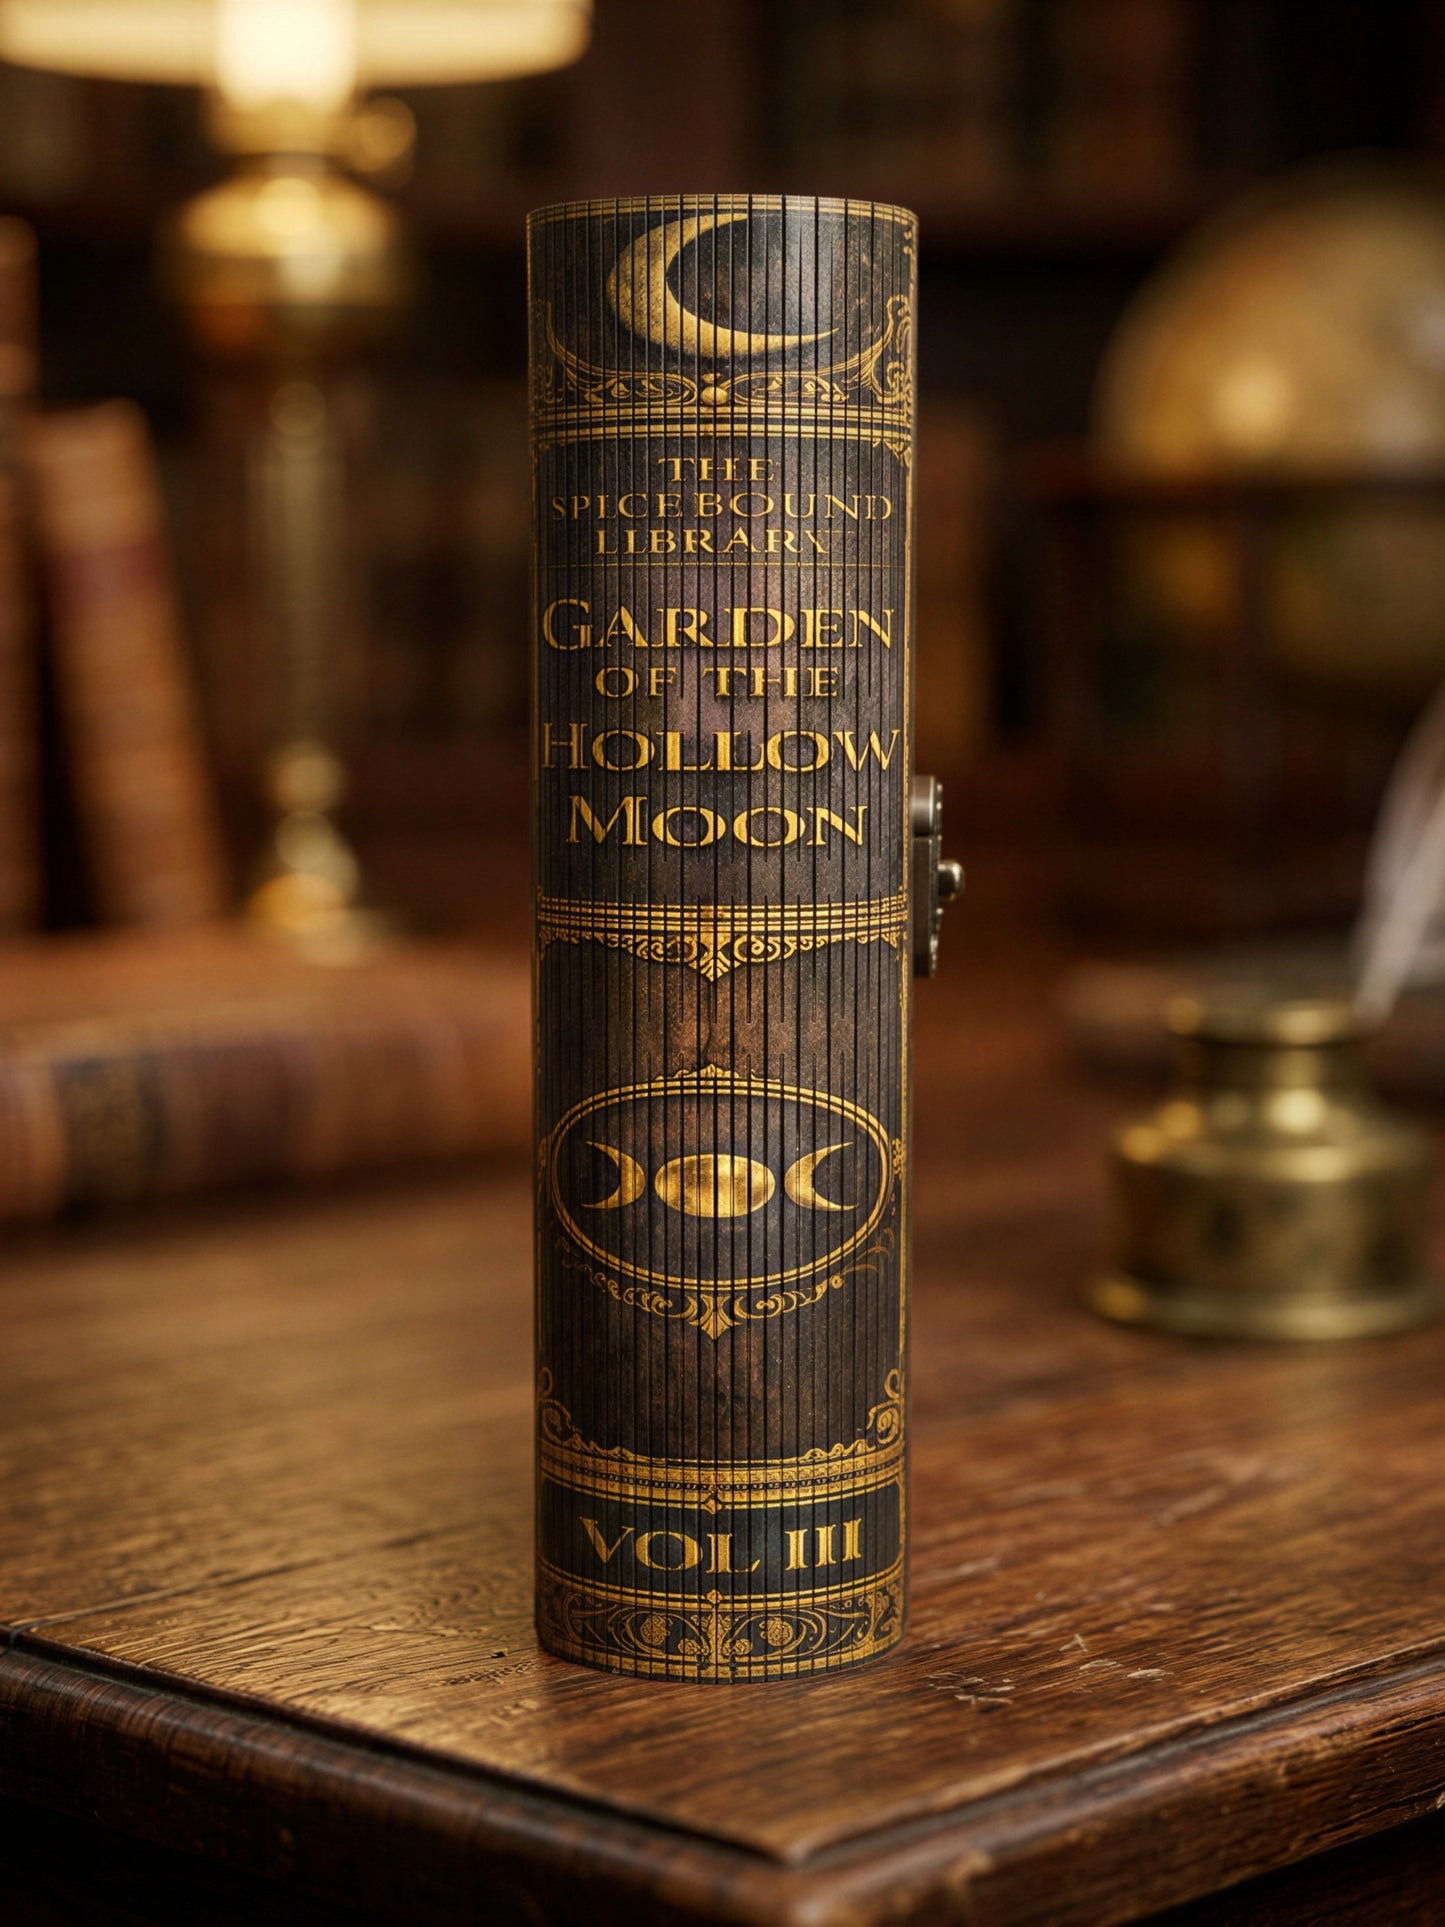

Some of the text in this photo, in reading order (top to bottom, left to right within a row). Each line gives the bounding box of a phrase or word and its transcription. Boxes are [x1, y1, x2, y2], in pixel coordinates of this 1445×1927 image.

[658, 457, 775, 482] THE
[542, 599, 895, 650] GARDEN
[595, 666, 839, 698] OF THE
[541, 722, 901, 772] HOLLOW
[565, 795, 868, 848] MOON
[784, 1517, 862, 1571] III
